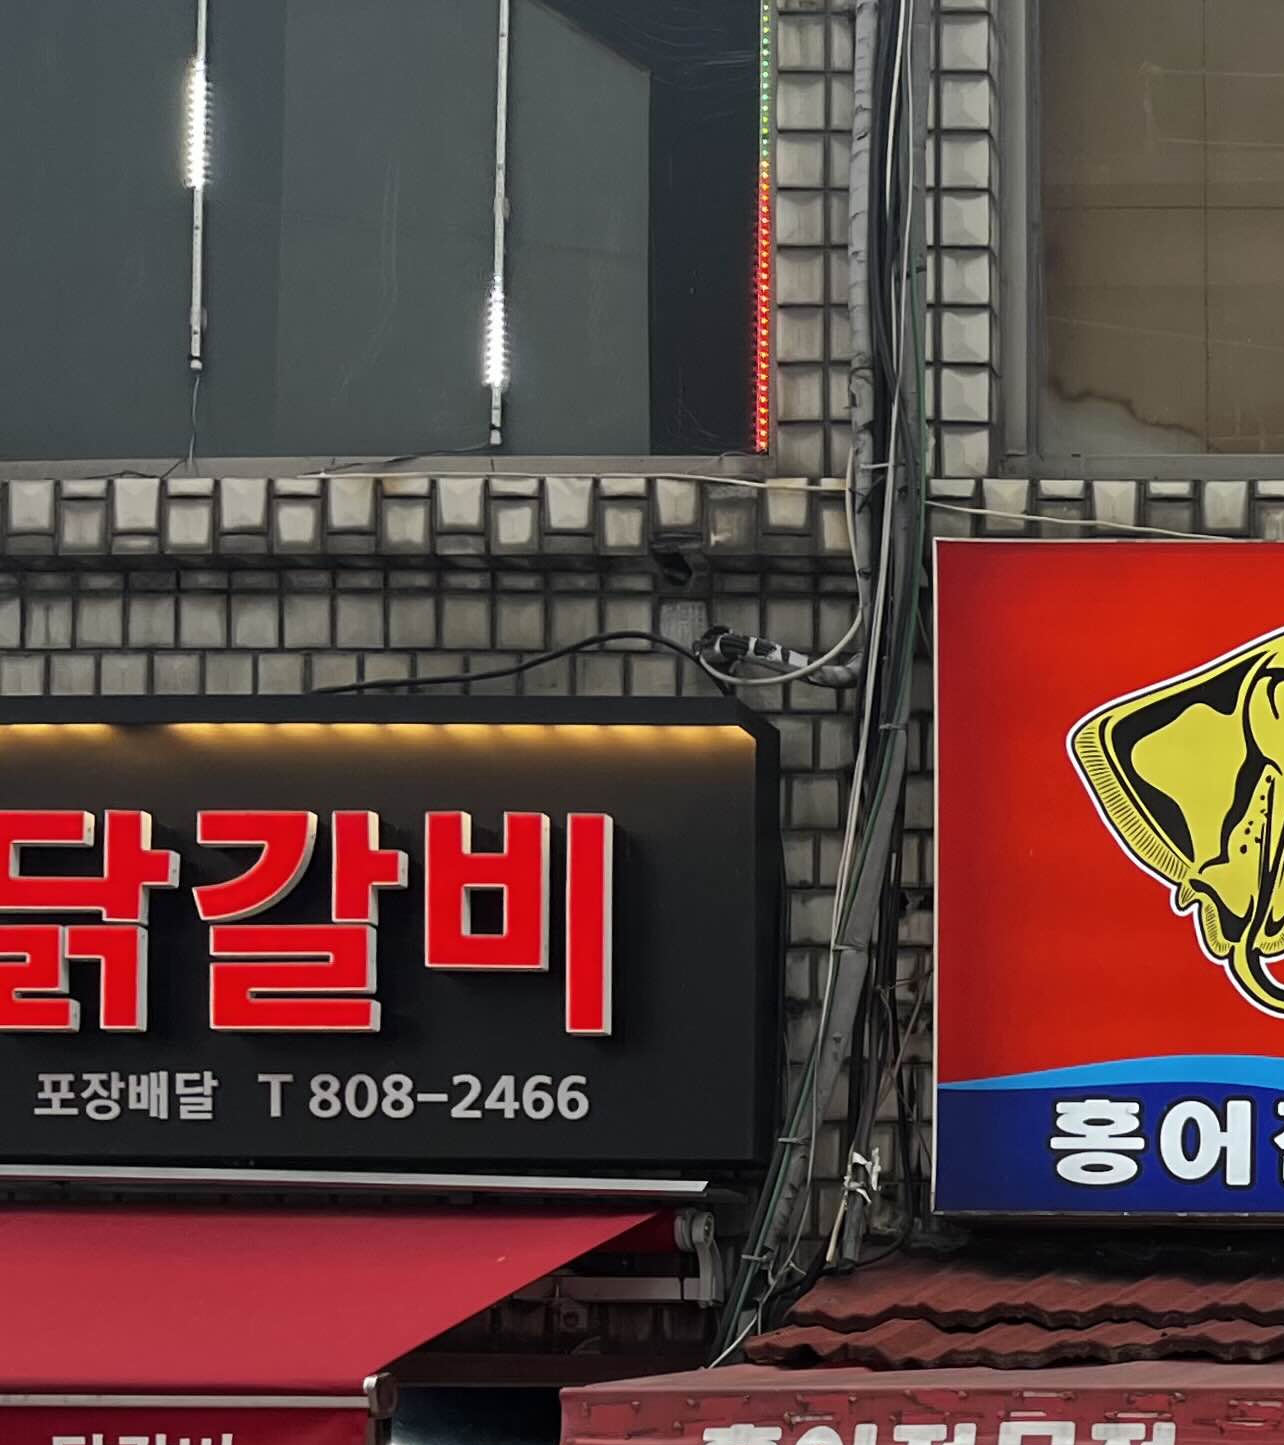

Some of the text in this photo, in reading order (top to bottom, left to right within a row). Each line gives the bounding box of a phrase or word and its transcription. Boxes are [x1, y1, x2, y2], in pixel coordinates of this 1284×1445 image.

[0, 810, 615, 1036] 닭갈비
[32, 1071, 590, 1122] 포장배달 T 808-2466
